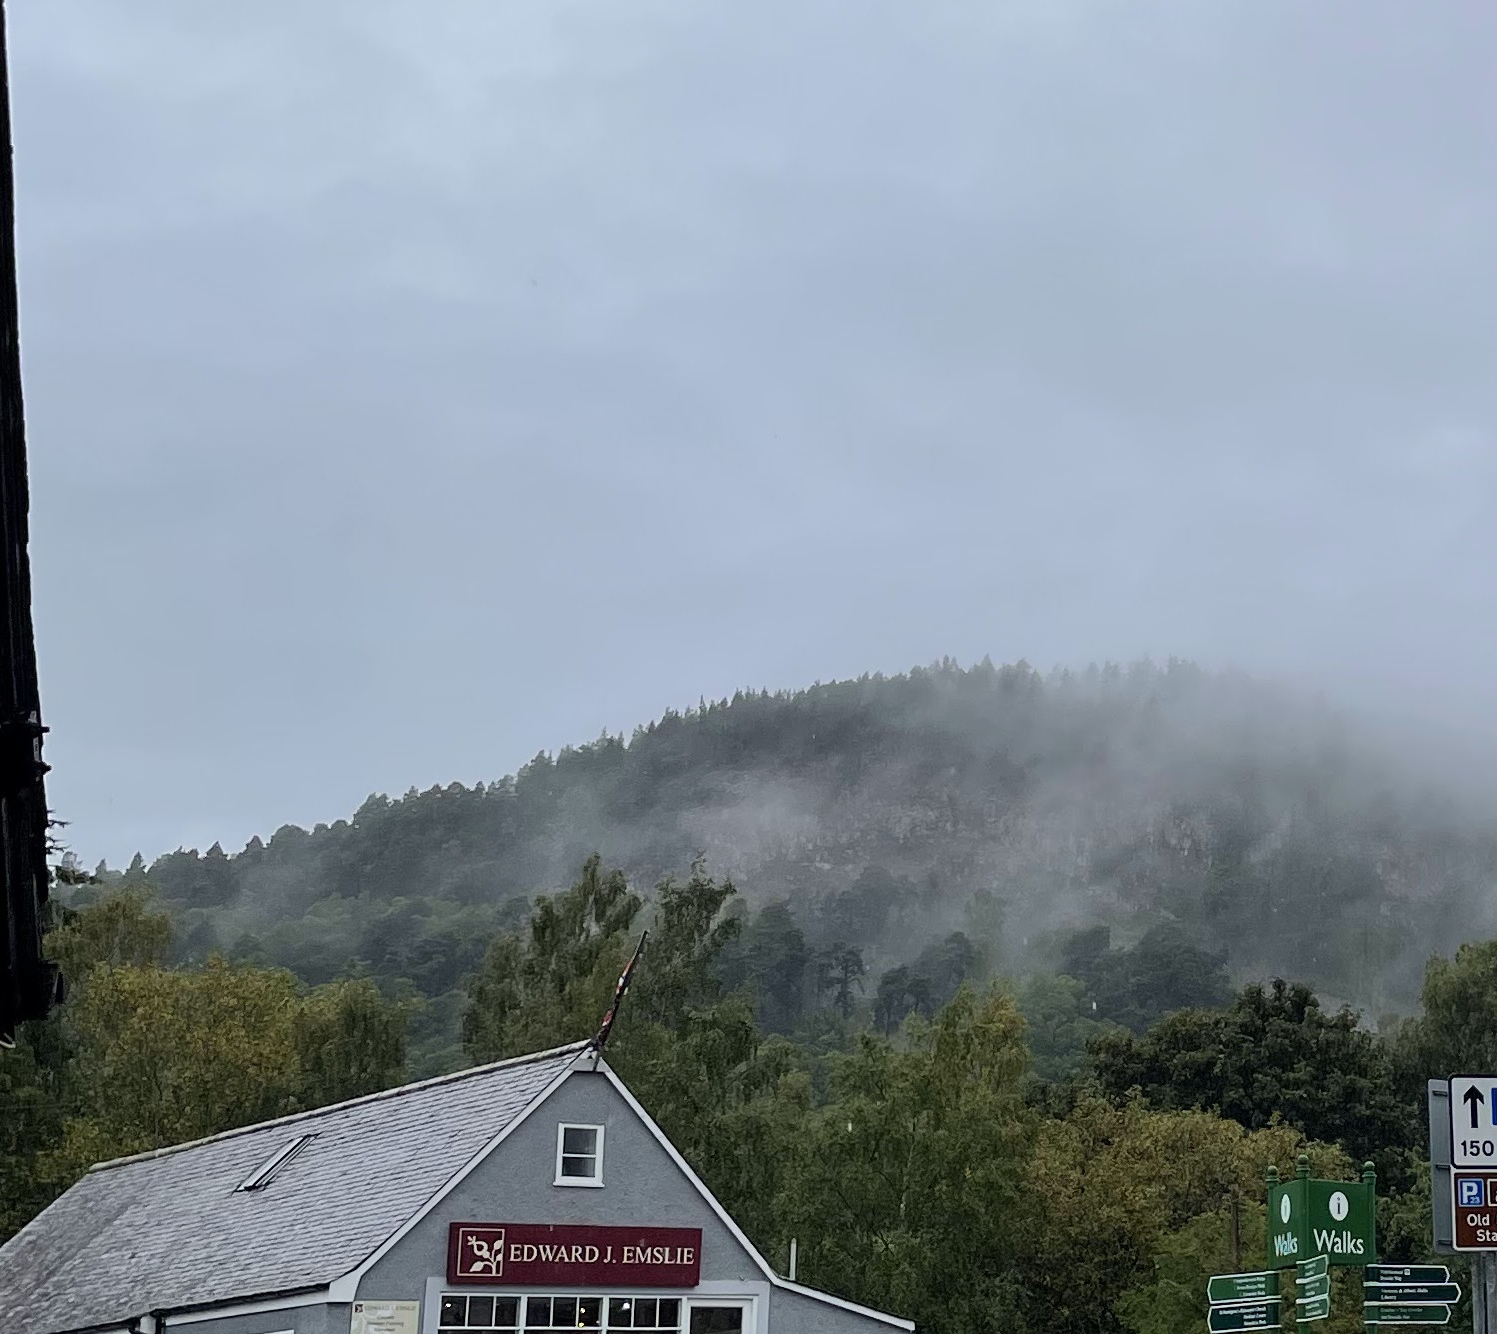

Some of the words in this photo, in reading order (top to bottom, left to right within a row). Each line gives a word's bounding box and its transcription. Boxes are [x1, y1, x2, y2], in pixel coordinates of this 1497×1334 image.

[1460, 1140, 1495, 1157] 150
[1466, 1213, 1490, 1227] Old
[1274, 1231, 1298, 1257] Walks
[1313, 1228, 1365, 1255] Walks
[509, 1244, 599, 1263] EDWARD
[603, 1246, 617, 1264] J.
[622, 1246, 695, 1265] EMSLIE
